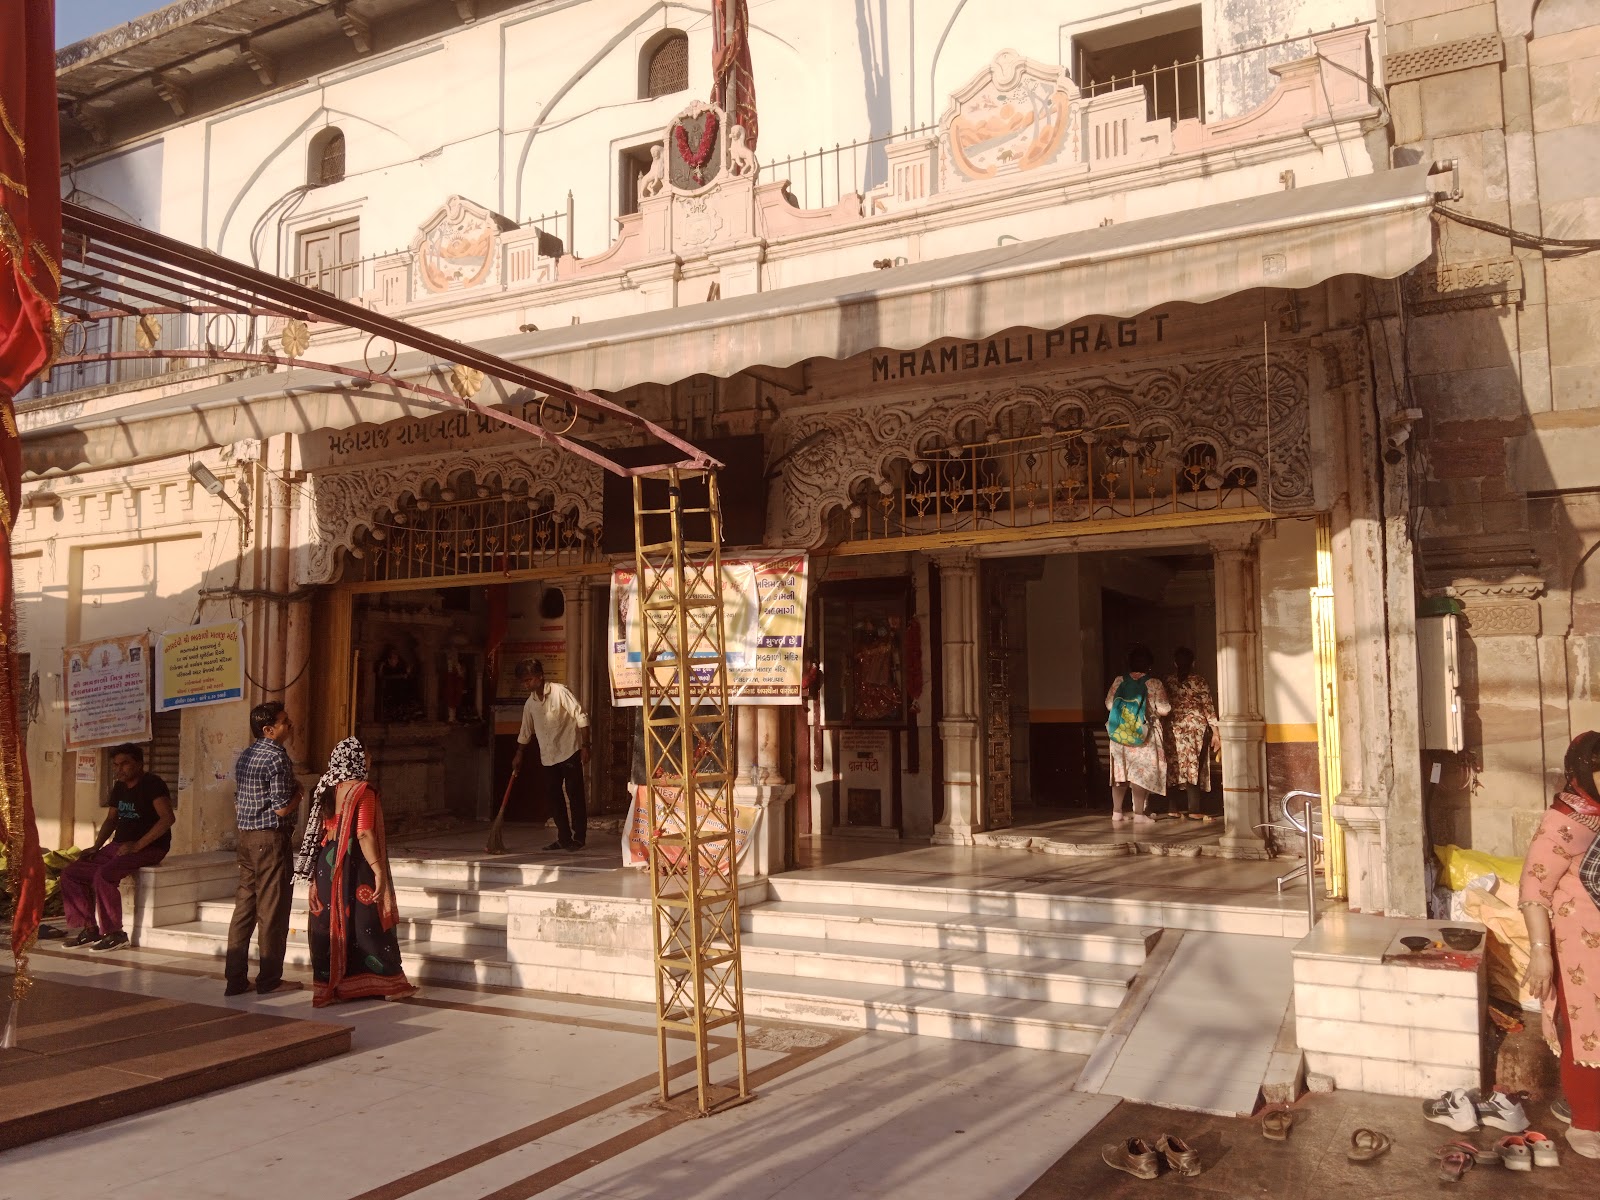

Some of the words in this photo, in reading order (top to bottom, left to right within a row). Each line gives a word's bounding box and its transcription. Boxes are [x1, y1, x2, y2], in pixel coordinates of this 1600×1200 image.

[872, 334, 1033, 382] M.RAMBALI
[1046, 319, 1137, 358] PRAG
[328, 426, 391, 455] મહારાજ
[397, 411, 470, 444] રામબલી
[764, 604, 795, 615] સહભાગી
[783, 651, 799, 662] મંદિર
[849, 761, 863, 772] दान
[865, 758, 879, 772] पेटी
